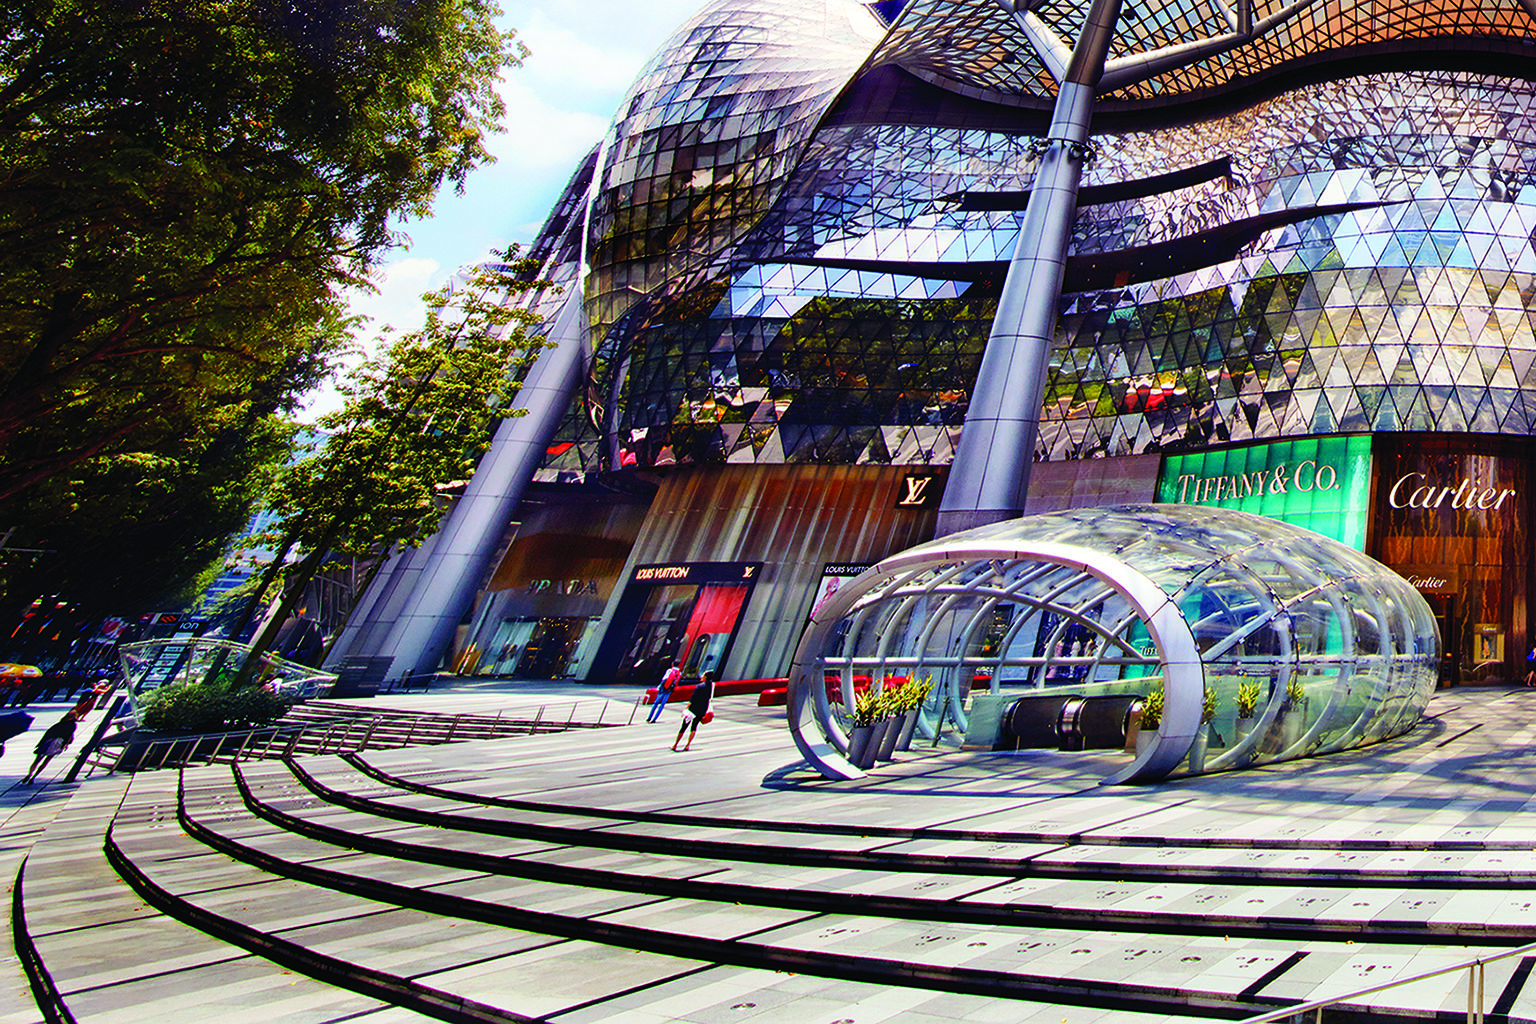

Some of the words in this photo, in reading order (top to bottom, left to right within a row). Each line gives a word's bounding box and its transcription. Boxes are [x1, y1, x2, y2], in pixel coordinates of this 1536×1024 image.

[1178, 470, 1269, 504] TIFFANY
[1269, 464, 1290, 494] &
[1389, 472, 1516, 510] Cartier
[635, 568, 655, 580] LOUIS
[654, 566, 690, 579] VUITTON
[825, 566, 846, 574] LOUIS
[847, 566, 869, 574] VUITTO
